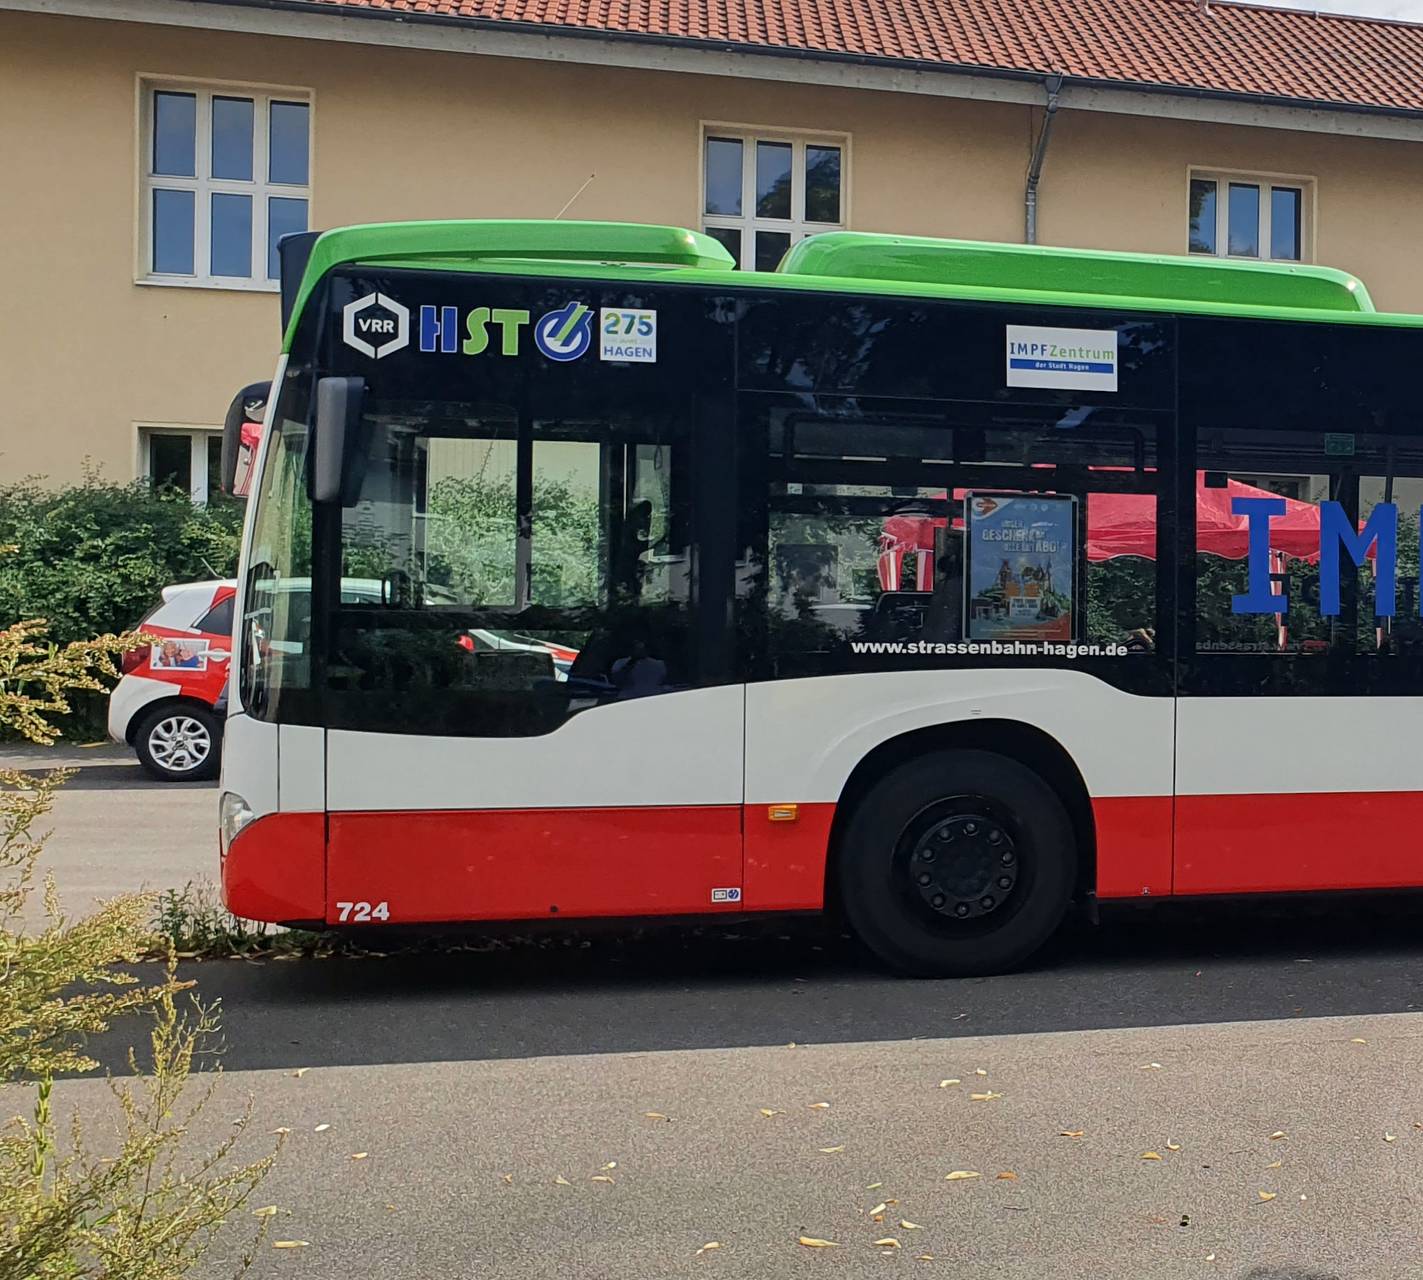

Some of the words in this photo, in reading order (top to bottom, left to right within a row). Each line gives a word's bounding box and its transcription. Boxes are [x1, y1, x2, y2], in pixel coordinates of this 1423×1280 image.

[358, 318, 395, 334] VRR
[419, 304, 530, 356] HST
[604, 312, 653, 336] 275
[604, 346, 652, 358] HAGEN
[1010, 342, 1114, 359] IMPFZentrum
[1048, 361, 1066, 370] Stadt
[1068, 363, 1090, 371] Hagen
[851, 640, 1128, 658] www.strassenbahn-hagen.de
[336, 901, 390, 922] 724
